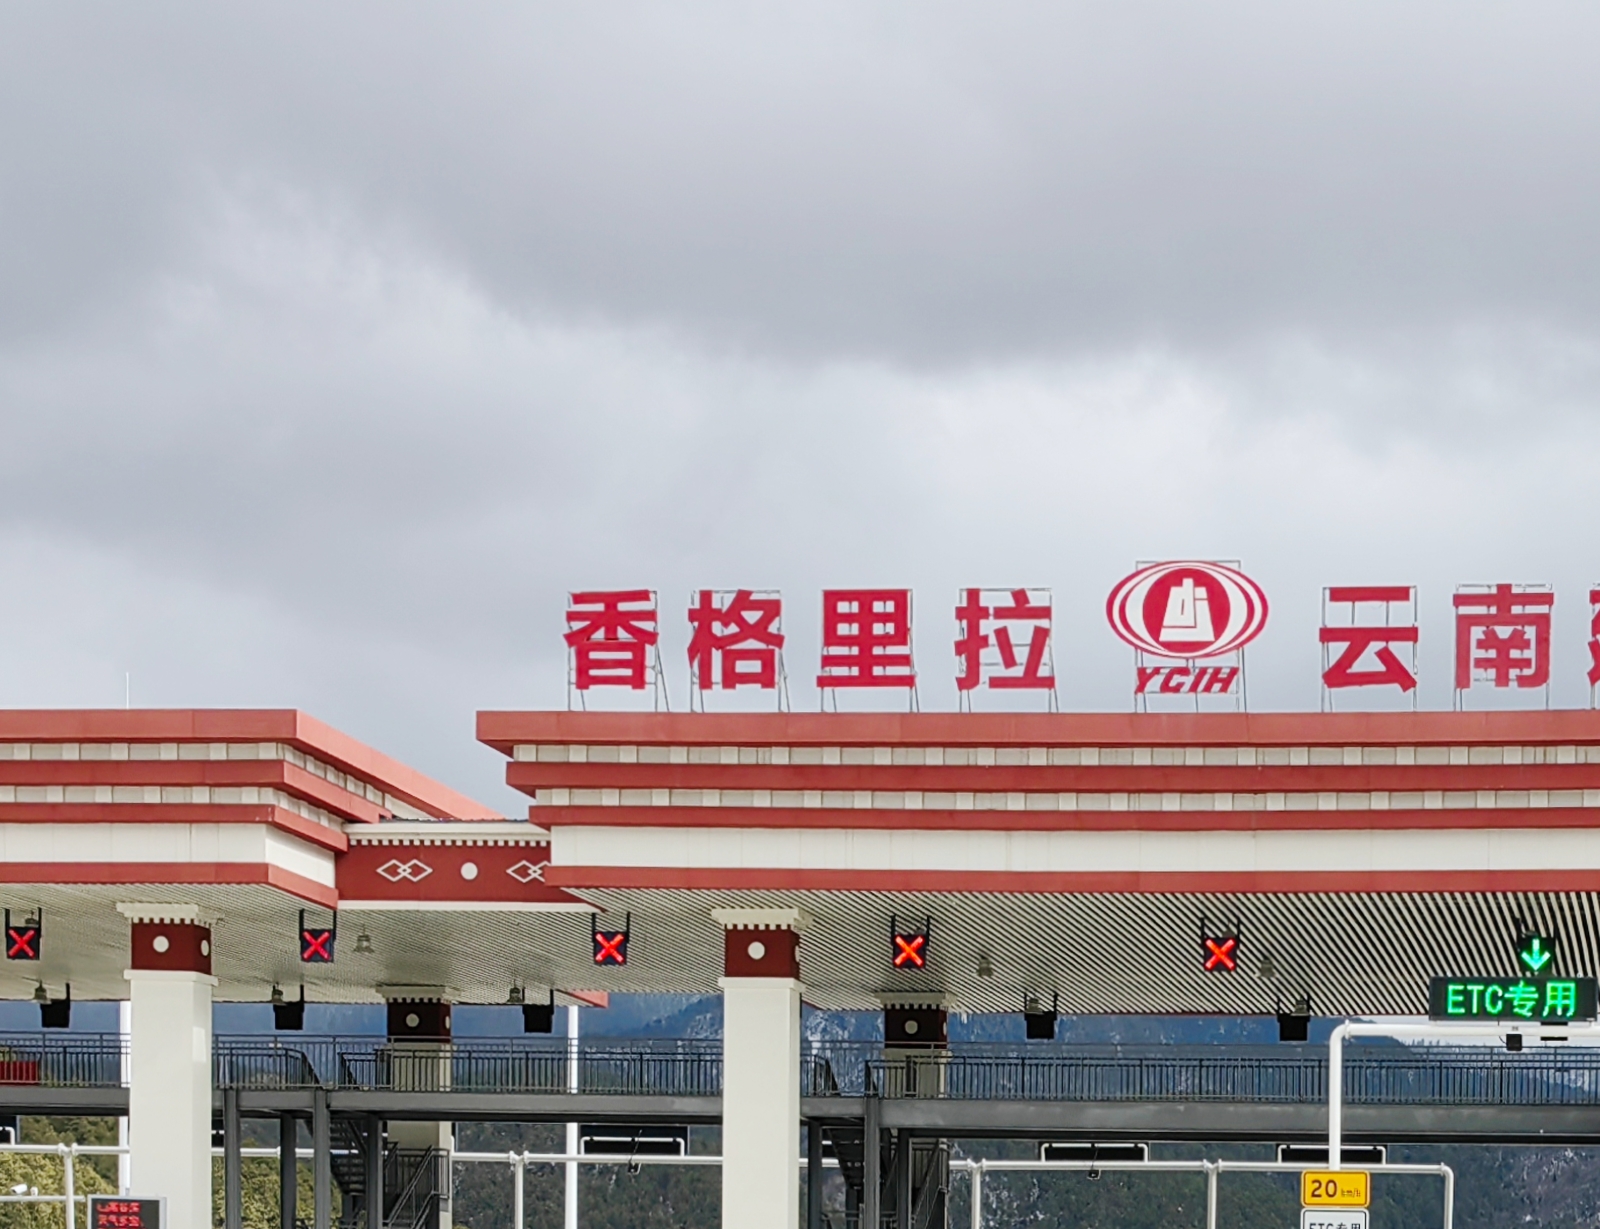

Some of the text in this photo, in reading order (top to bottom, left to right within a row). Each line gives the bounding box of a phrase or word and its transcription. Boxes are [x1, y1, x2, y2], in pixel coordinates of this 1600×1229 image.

[564, 588, 1056, 691] 香格里拉
[1134, 666, 1240, 694] YCIH
[1446, 980, 1577, 1018] ETC专用
[1311, 1179, 1338, 1198] 20
